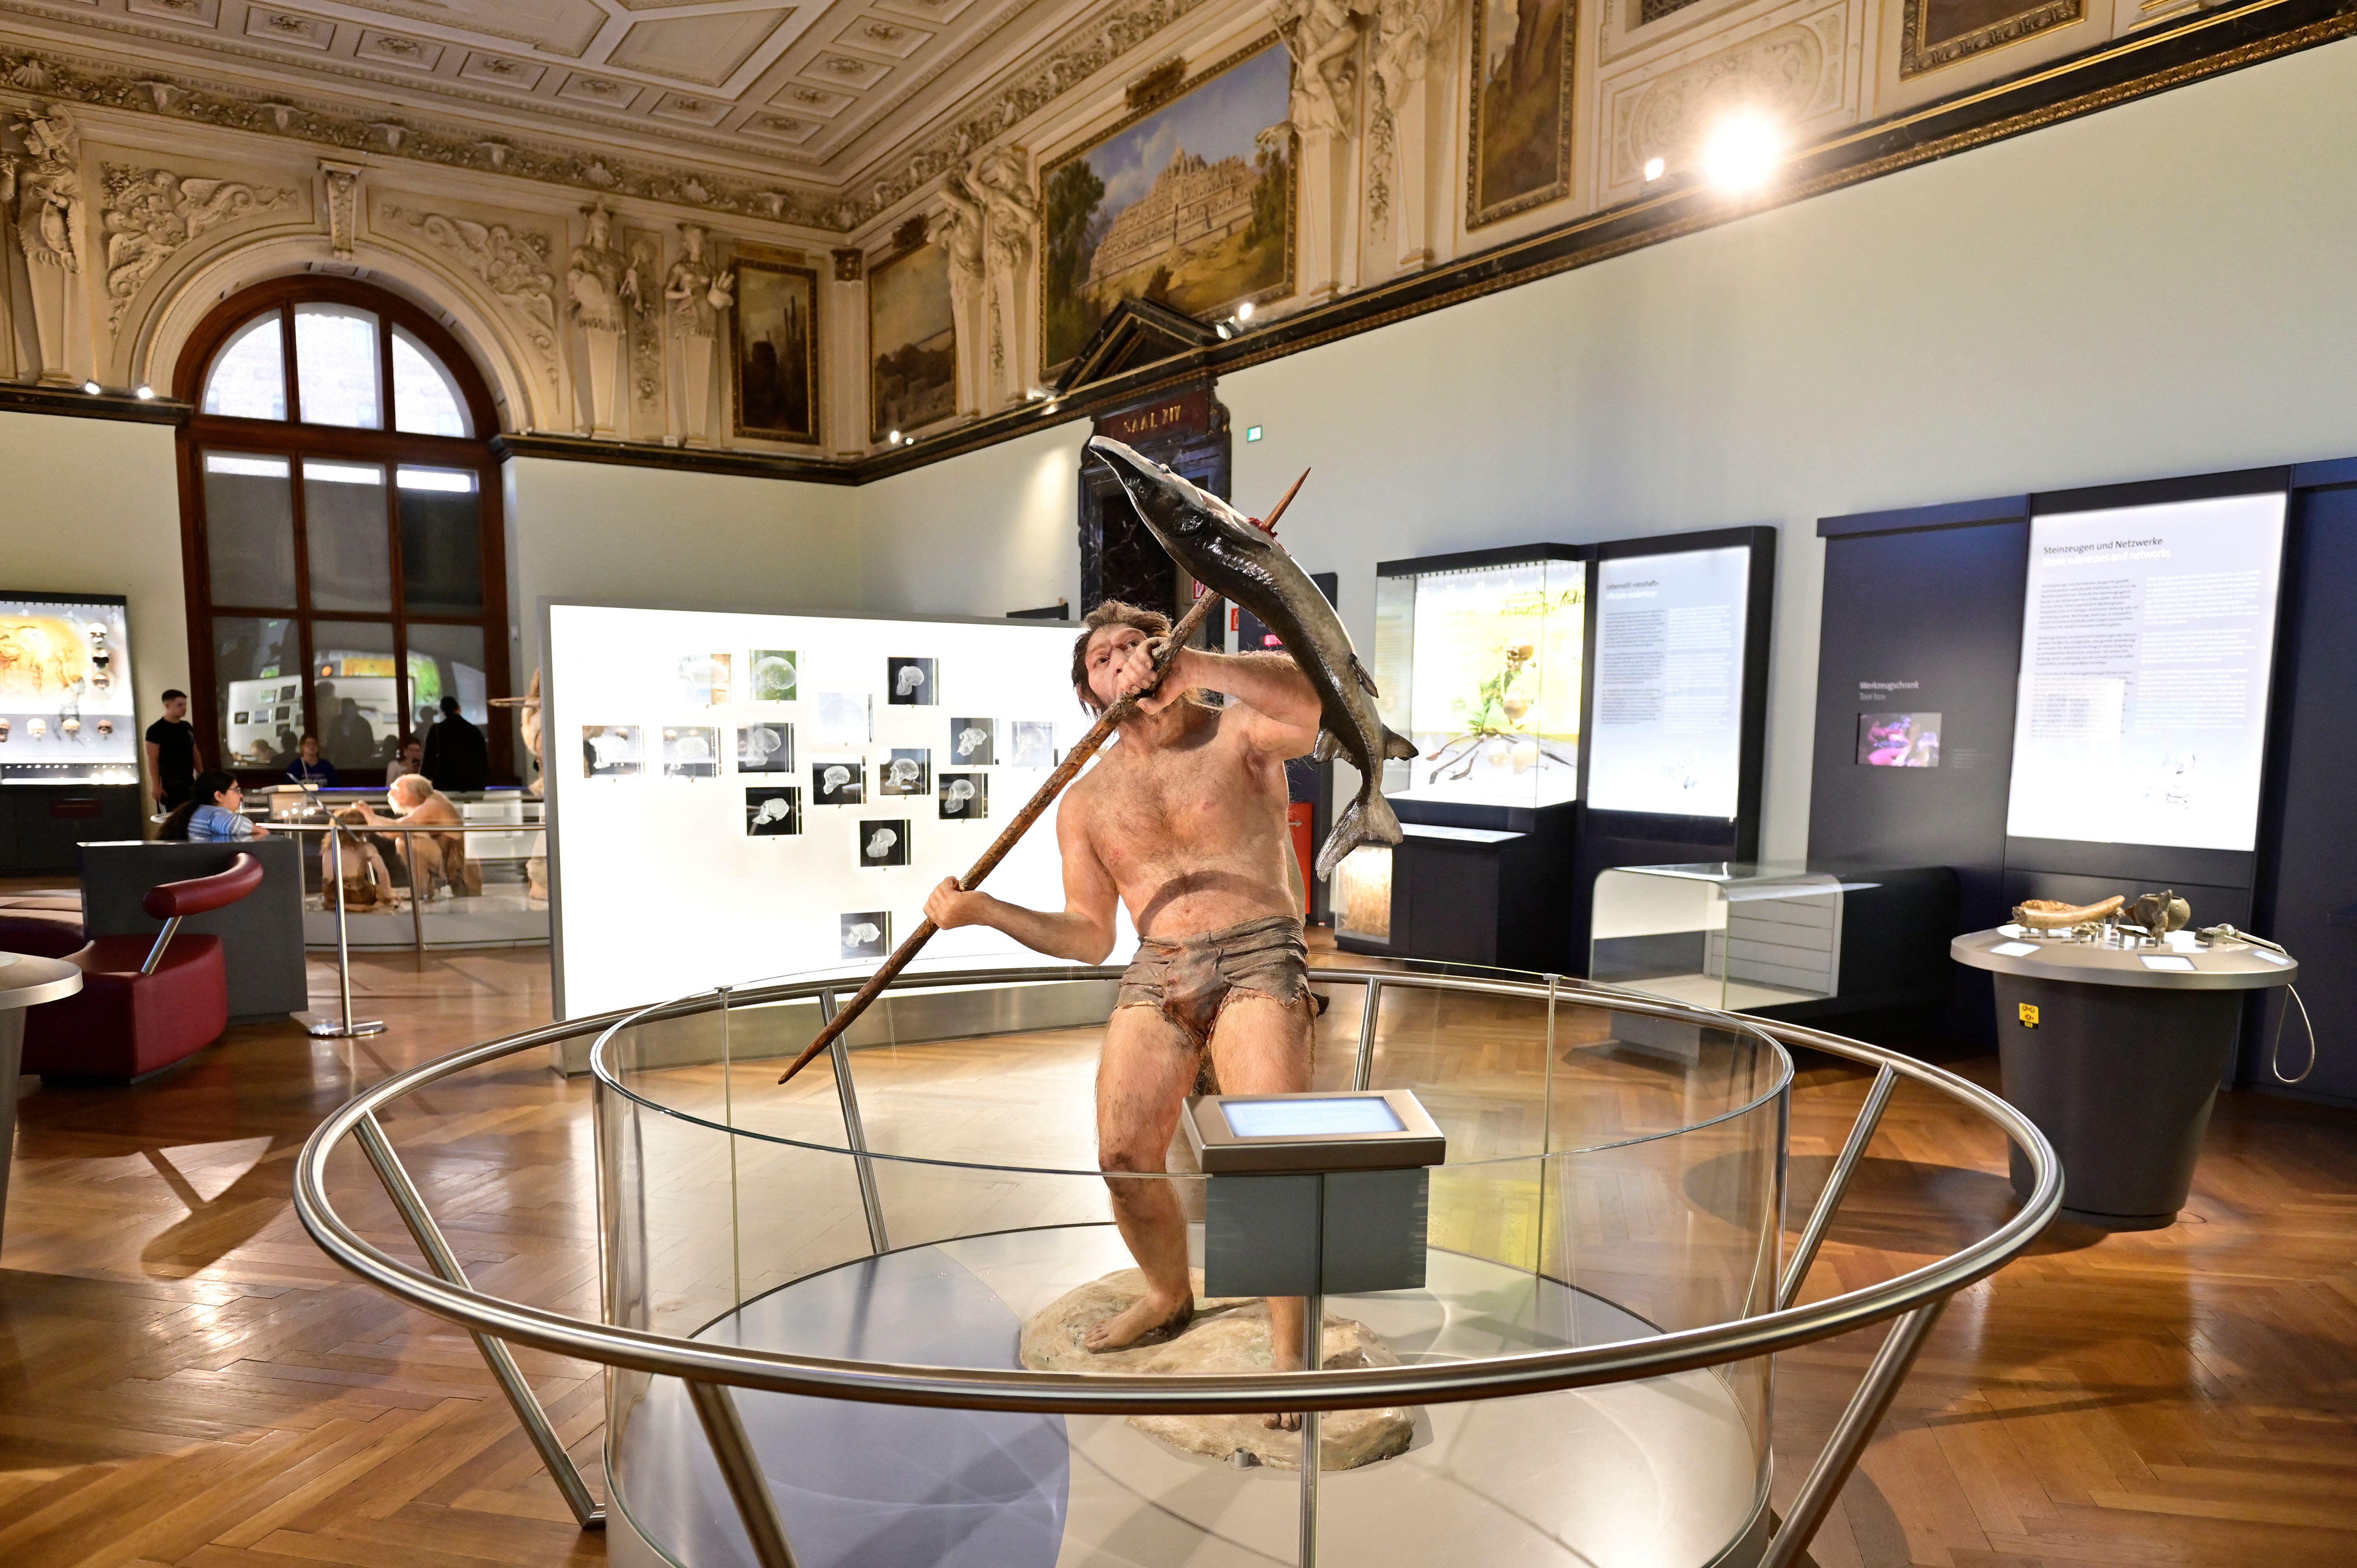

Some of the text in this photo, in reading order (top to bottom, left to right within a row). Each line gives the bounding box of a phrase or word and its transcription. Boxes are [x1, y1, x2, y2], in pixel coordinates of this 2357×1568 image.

[2043, 537, 2163, 554] Steinzeugen und Netzwerke
[2042, 548, 2171, 567] Stone witnesses and networks
[1859, 680, 1920, 692] Werkzeugschrank
